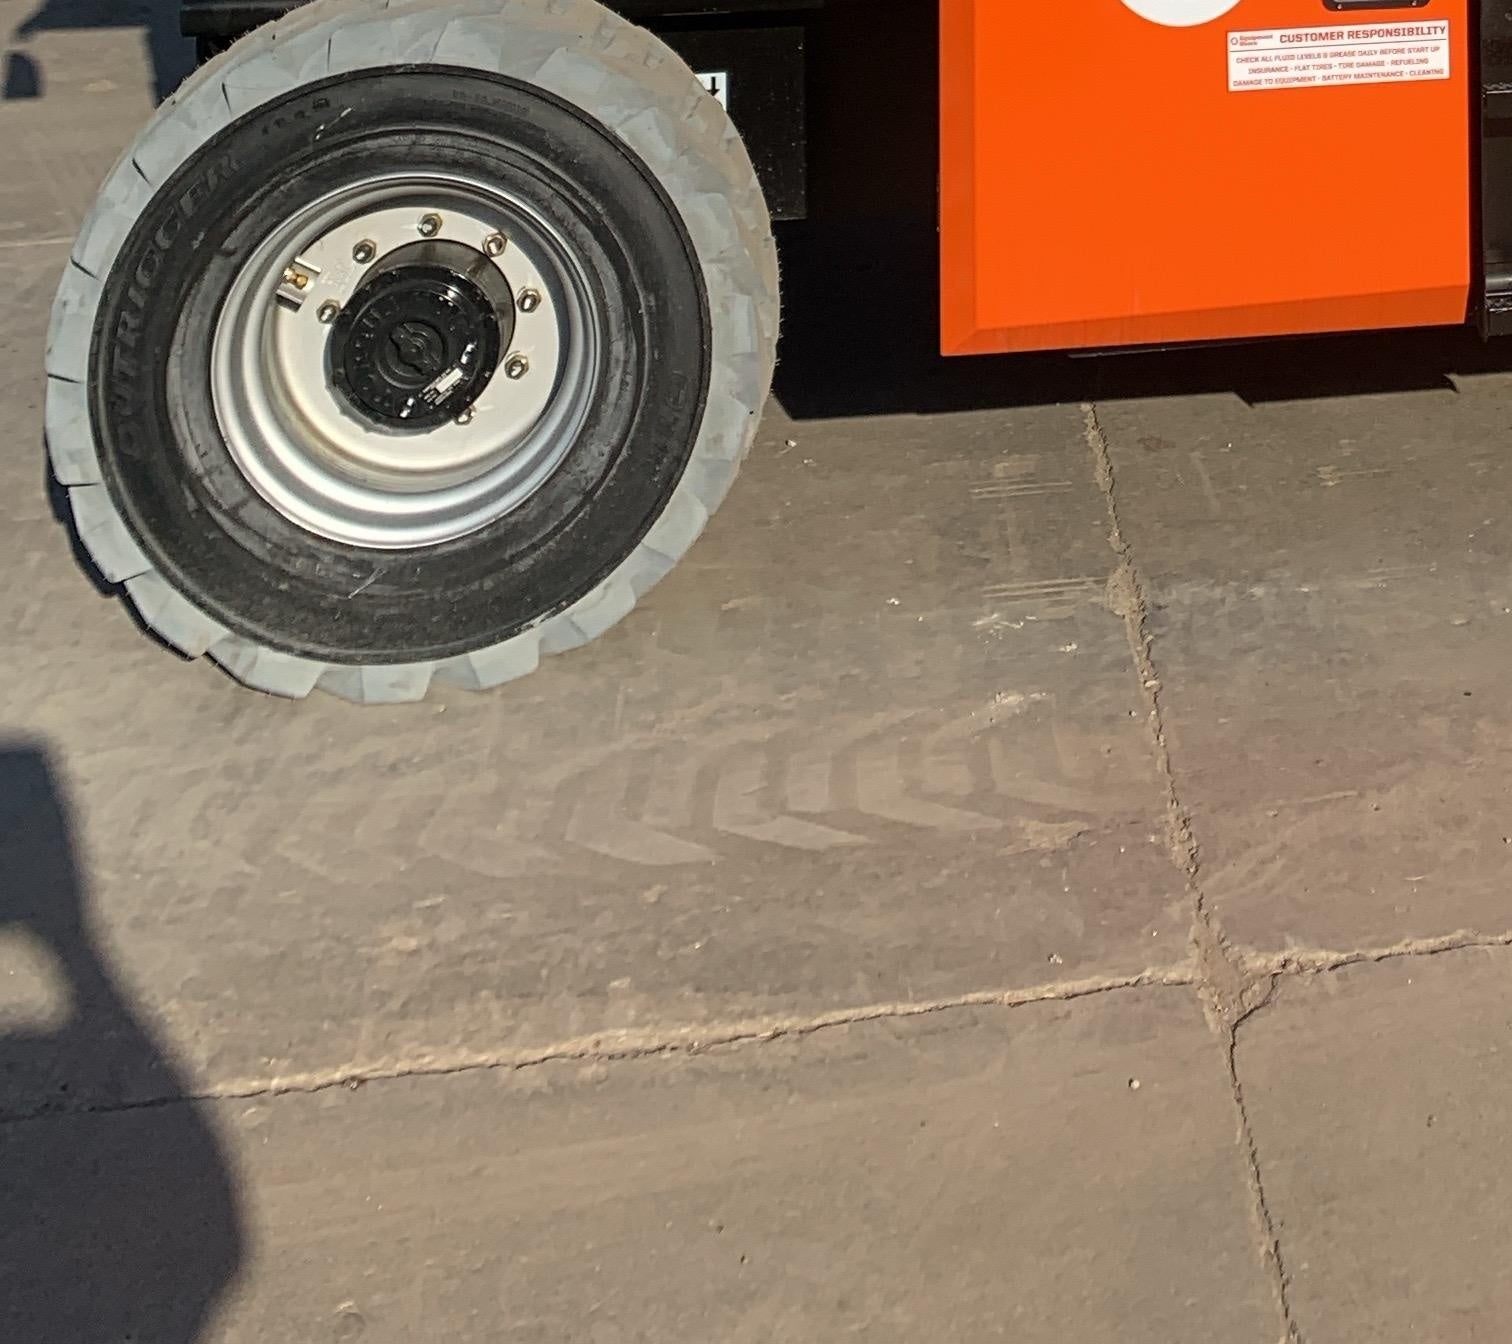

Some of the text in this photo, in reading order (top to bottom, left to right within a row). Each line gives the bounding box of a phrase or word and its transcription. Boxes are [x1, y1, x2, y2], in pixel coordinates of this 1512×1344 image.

[1280, 26, 1446, 44] CUSTOMER RESPONSIBILITY
[1329, 50, 1357, 58] GREASE
[1358, 49, 1378, 57] DAILY
[1380, 47, 1406, 55] BEFORE
[1407, 46, 1429, 54] START
[1248, 66, 1289, 74] INSURANCE
[1391, 58, 1429, 66] REFUELING
[1233, 79, 1262, 87] DAMAGE
[1275, 75, 1316, 84] EQUIPMENT
[1353, 71, 1404, 80] MAINTENANCE
[1409, 68, 1444, 77] CLEANING
